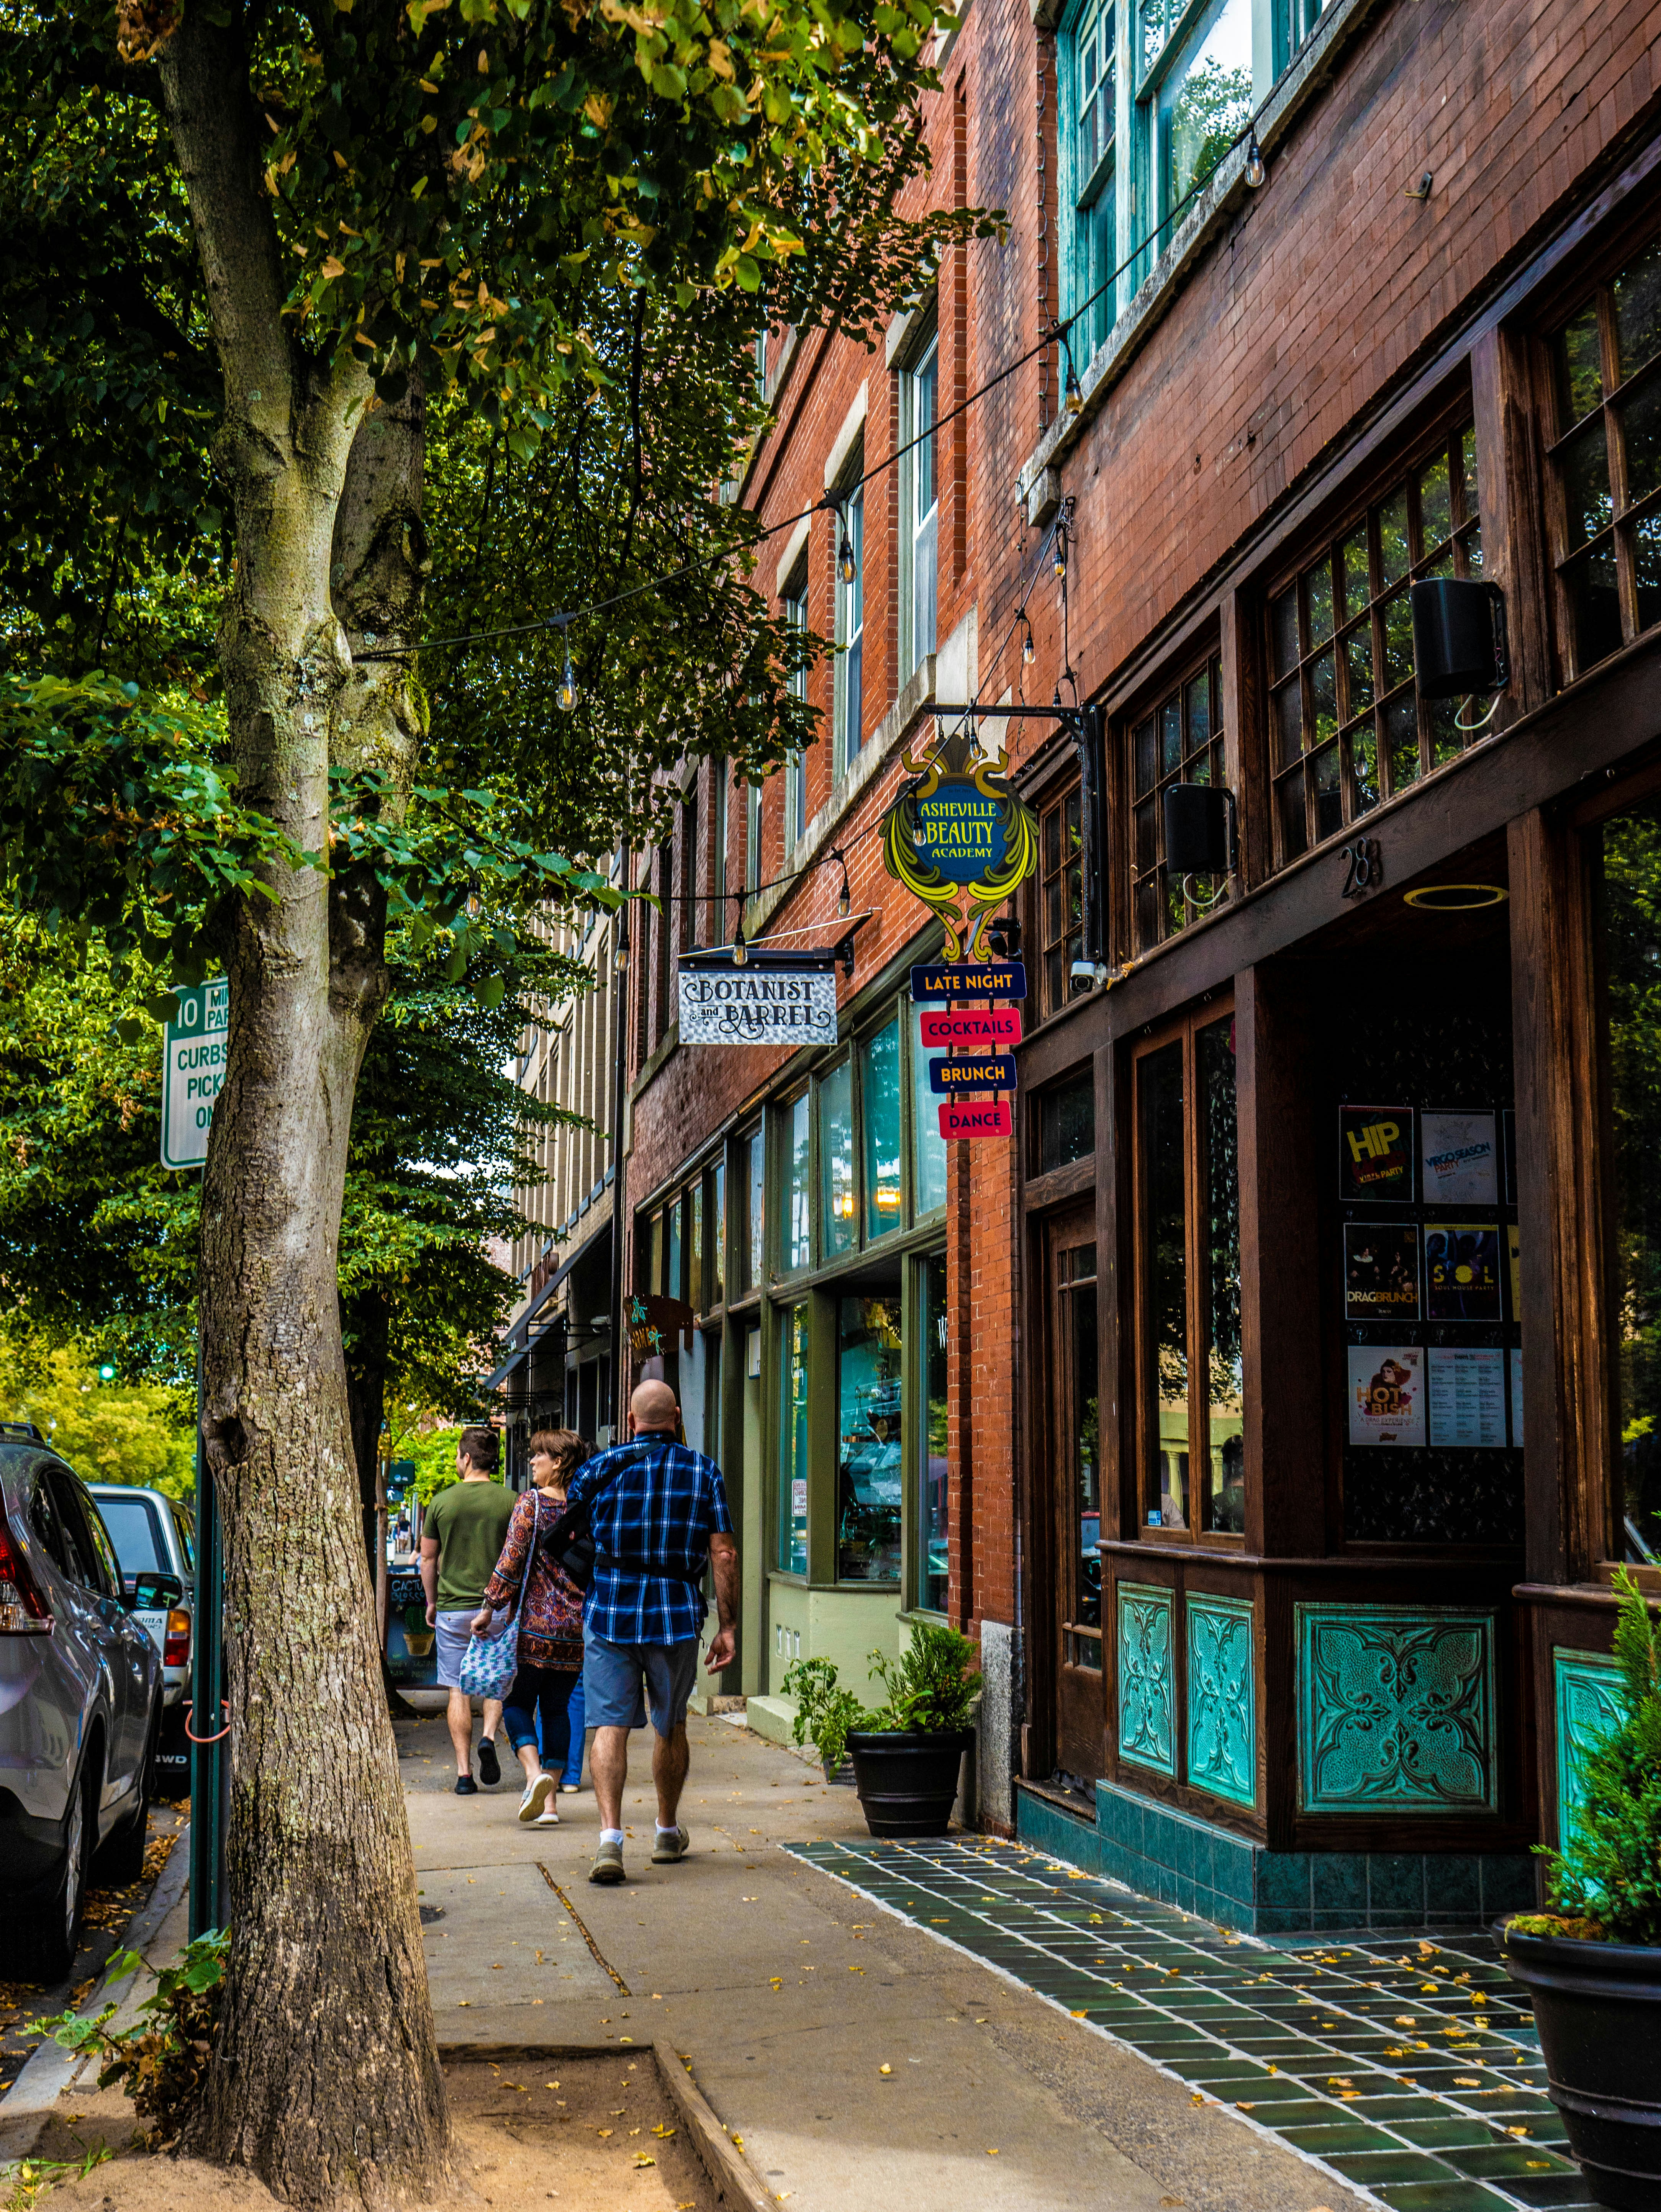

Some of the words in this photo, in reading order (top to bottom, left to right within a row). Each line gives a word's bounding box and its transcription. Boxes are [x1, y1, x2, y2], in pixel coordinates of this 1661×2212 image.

[921, 803, 996, 817] ASHEVILLE
[926, 821, 993, 844] BEAUTY
[932, 847, 992, 858] ACADEMY
[1340, 837, 1372, 898] 28
[925, 976, 960, 990] LATE
[966, 974, 1013, 989] NIGHT
[685, 980, 815, 1003] BOTANIST
[178, 998, 198, 1029] 10
[701, 1007, 719, 1016] and
[719, 1005, 831, 1040] BARREL
[929, 1020, 1014, 1036] COCKTAILS
[178, 1042, 227, 1071] CURBS
[941, 1066, 1005, 1082] BRUNCH
[187, 1073, 226, 1100] PICK
[949, 1113, 1001, 1128] DANCE
[1347, 1122, 1400, 1162] HIP
[1425, 1152, 1455, 1167] VIRGO
[1455, 1142, 1491, 1160] SEASON
[1381, 1166, 1403, 1178] PARTY
[1434, 1159, 1459, 1173] PARTY
[1356, 1386, 1402, 1403] HOT
[1372, 1403, 1412, 1416] BISH
[391, 1579, 423, 1592] CACTU
[391, 1592, 425, 1602] BLOSSO
